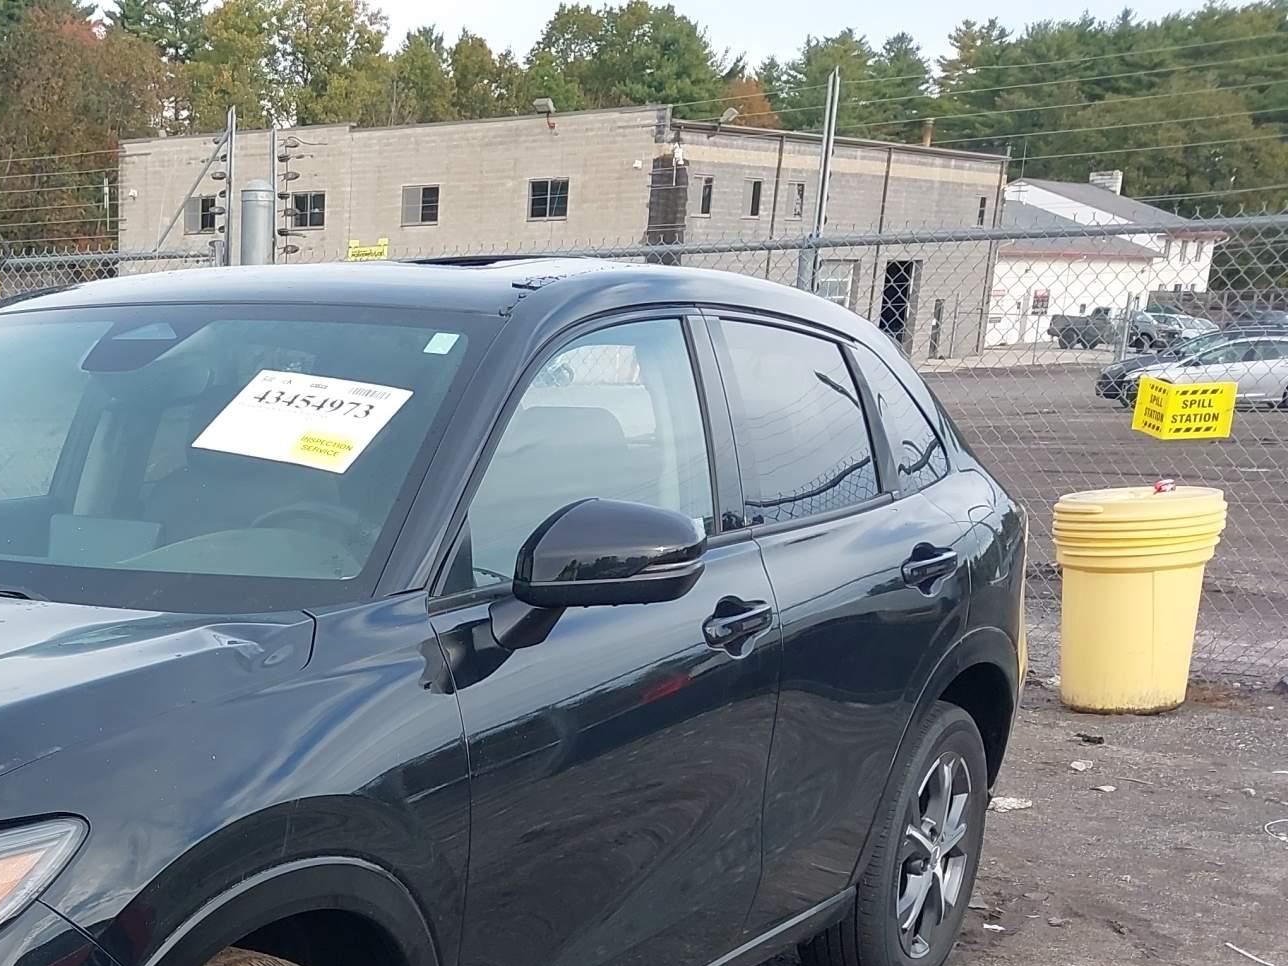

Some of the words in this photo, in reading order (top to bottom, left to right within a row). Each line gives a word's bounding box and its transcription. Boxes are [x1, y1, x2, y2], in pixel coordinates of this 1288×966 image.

[253, 389, 375, 419] 43454973
[1149, 393, 1164, 408] SPILL
[1181, 398, 1214, 410] SPILL
[1144, 406, 1164, 424] STATION
[1170, 412, 1220, 424] STATION
[300, 435, 354, 451] INSPECTION
[300, 444, 340, 457] SERVICE
